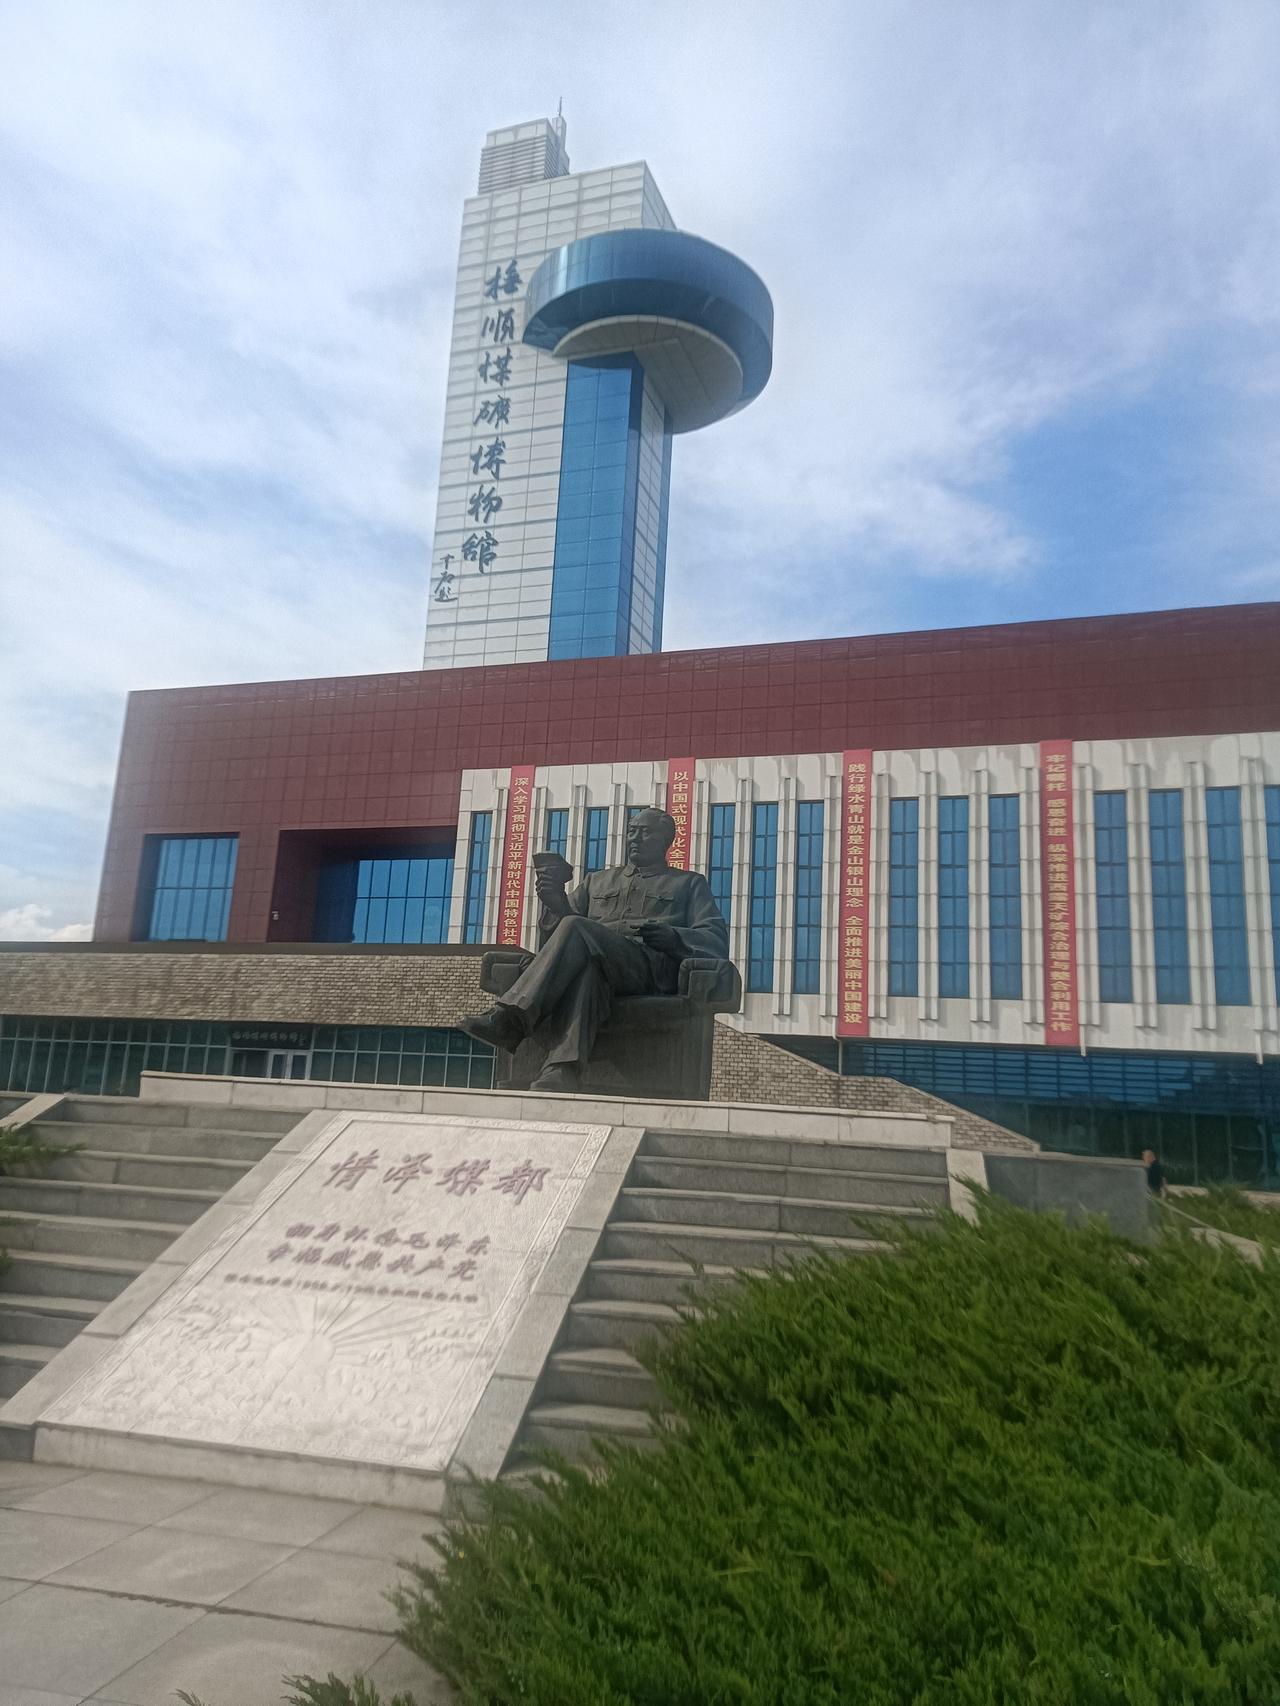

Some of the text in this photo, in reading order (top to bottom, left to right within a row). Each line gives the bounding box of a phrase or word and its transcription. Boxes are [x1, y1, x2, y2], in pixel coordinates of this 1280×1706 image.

[1046, 754, 1067, 792] 牢记嘱托
[1046, 798, 1067, 837] 感恩奋进
[844, 763, 866, 1024] 践行绿水青山就是金山银山理念 全面推进美丽中国建设
